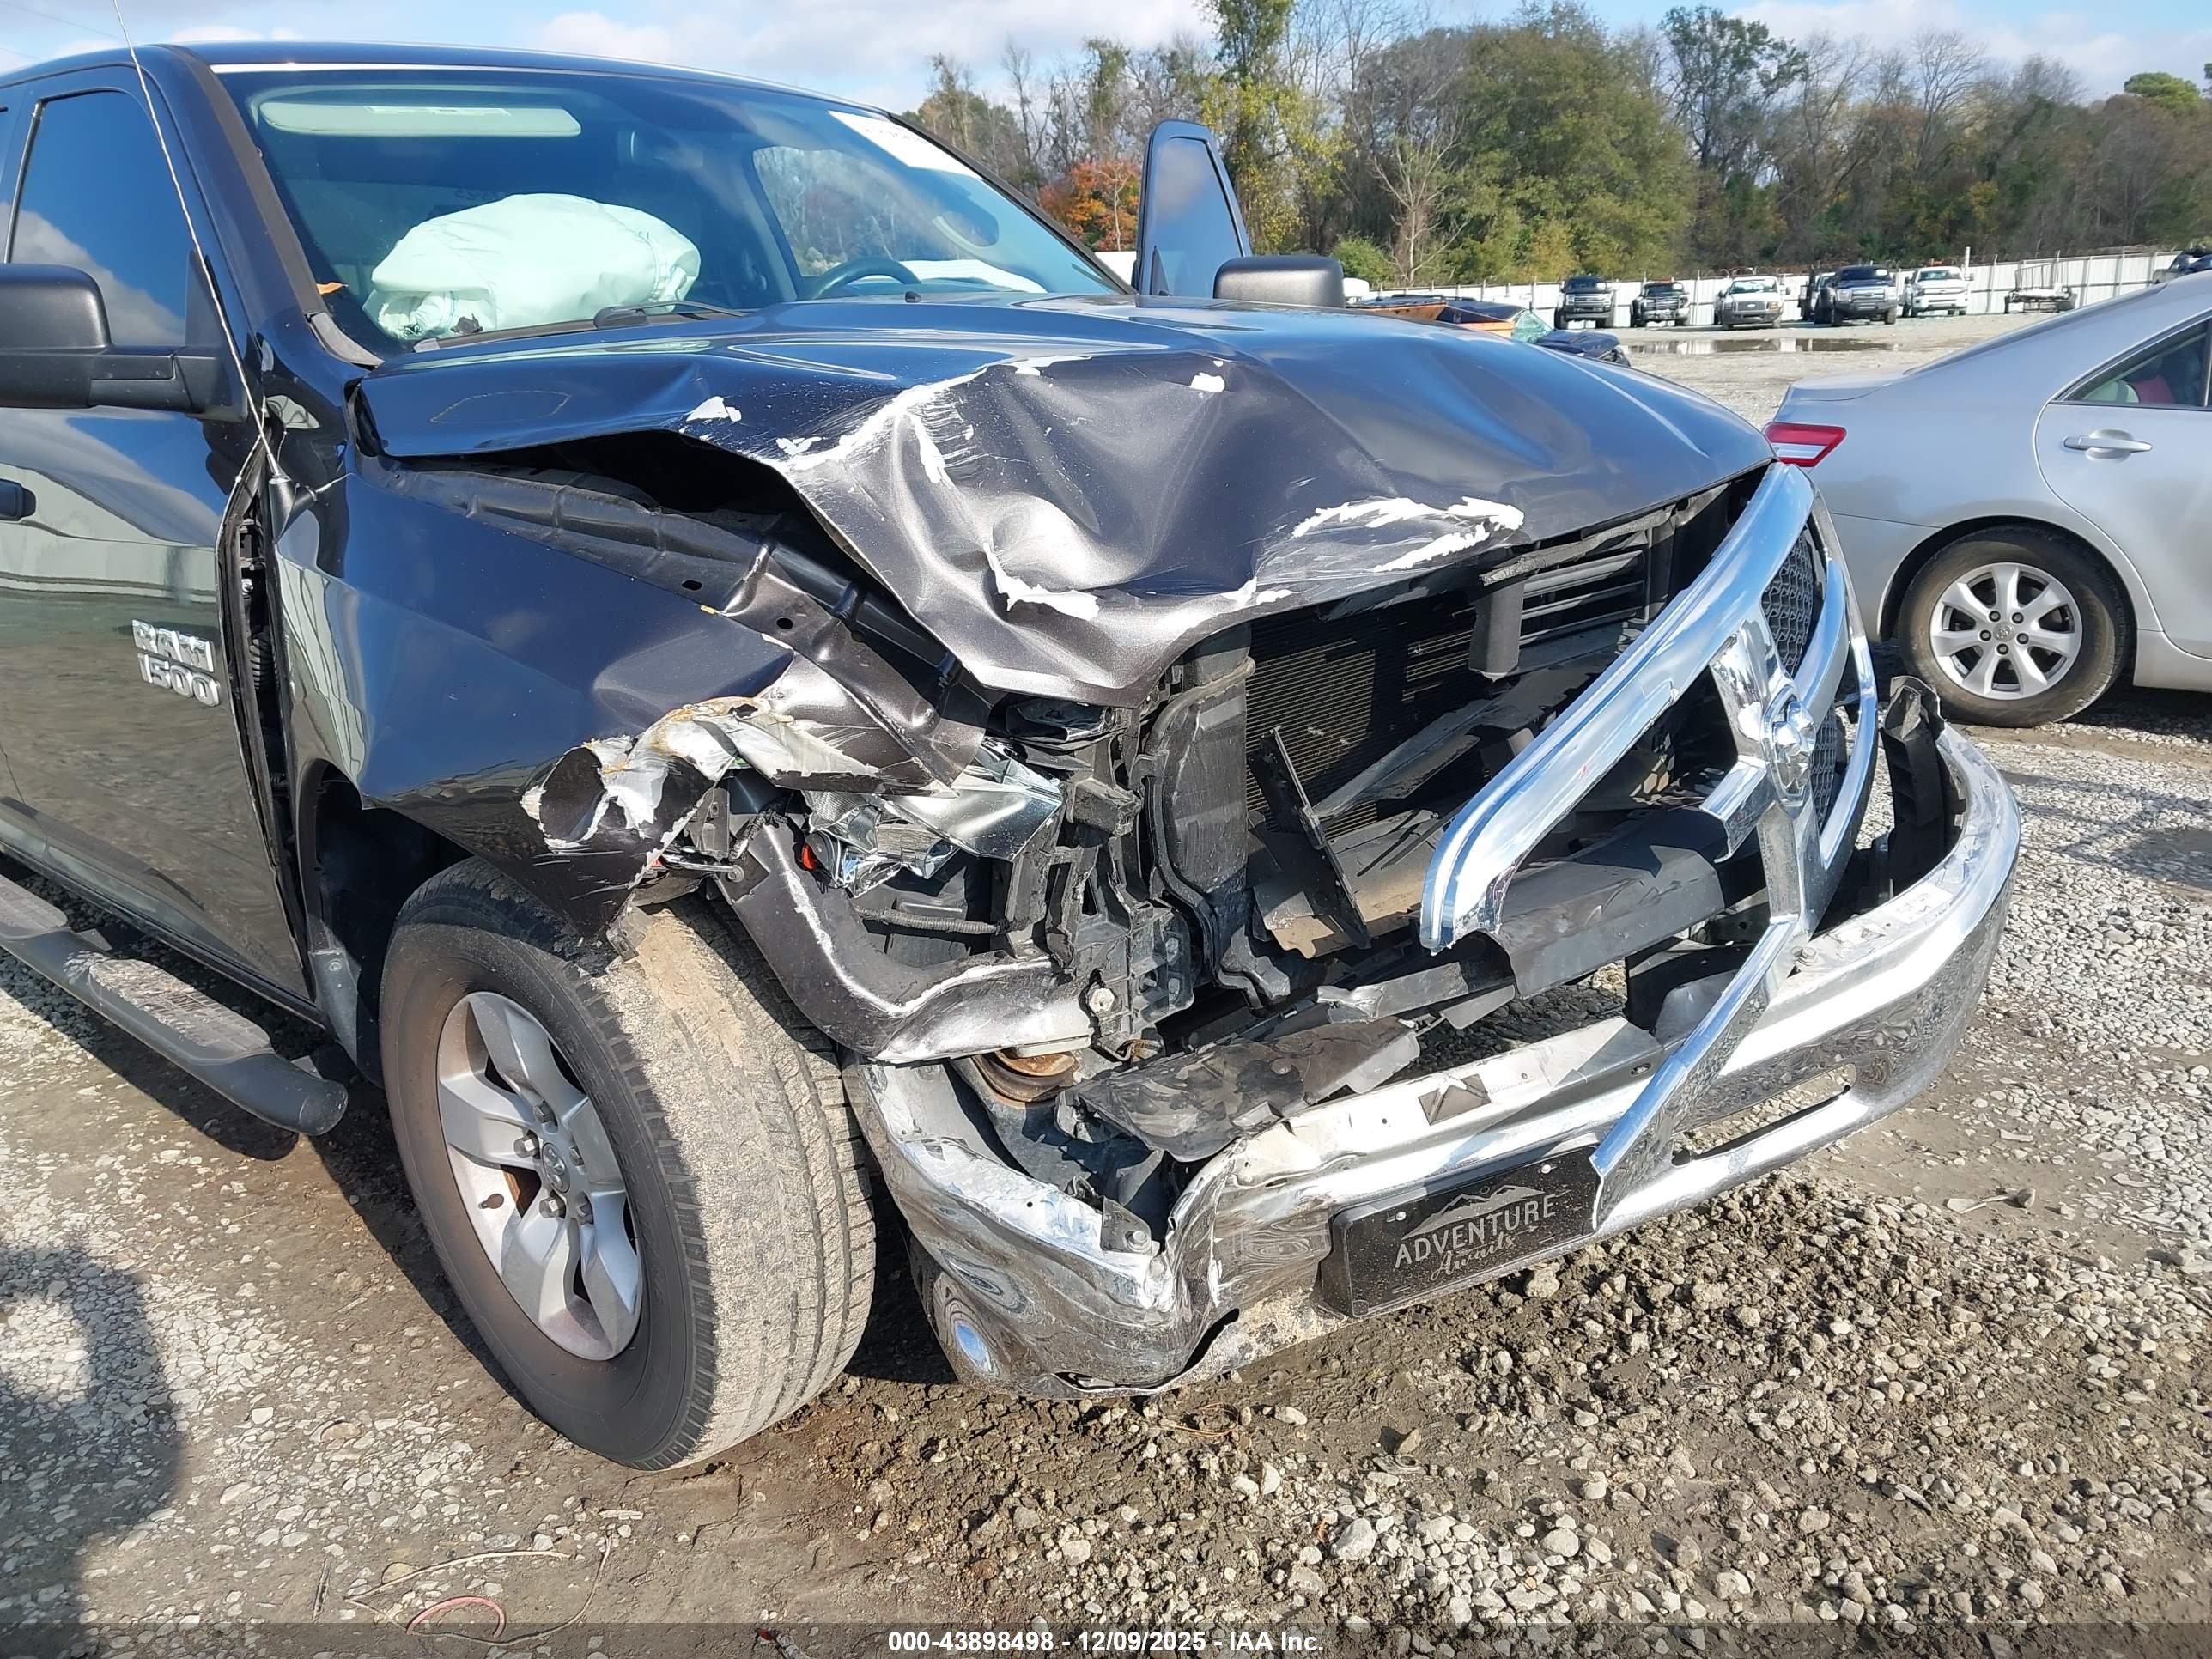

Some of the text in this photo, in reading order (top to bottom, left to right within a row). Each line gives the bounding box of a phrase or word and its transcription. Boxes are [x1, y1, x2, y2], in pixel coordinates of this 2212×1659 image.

[137, 653, 220, 707] 1500
[1395, 1194, 1556, 1268] ADVENTURE
[1430, 1235, 1516, 1281] Awaits
